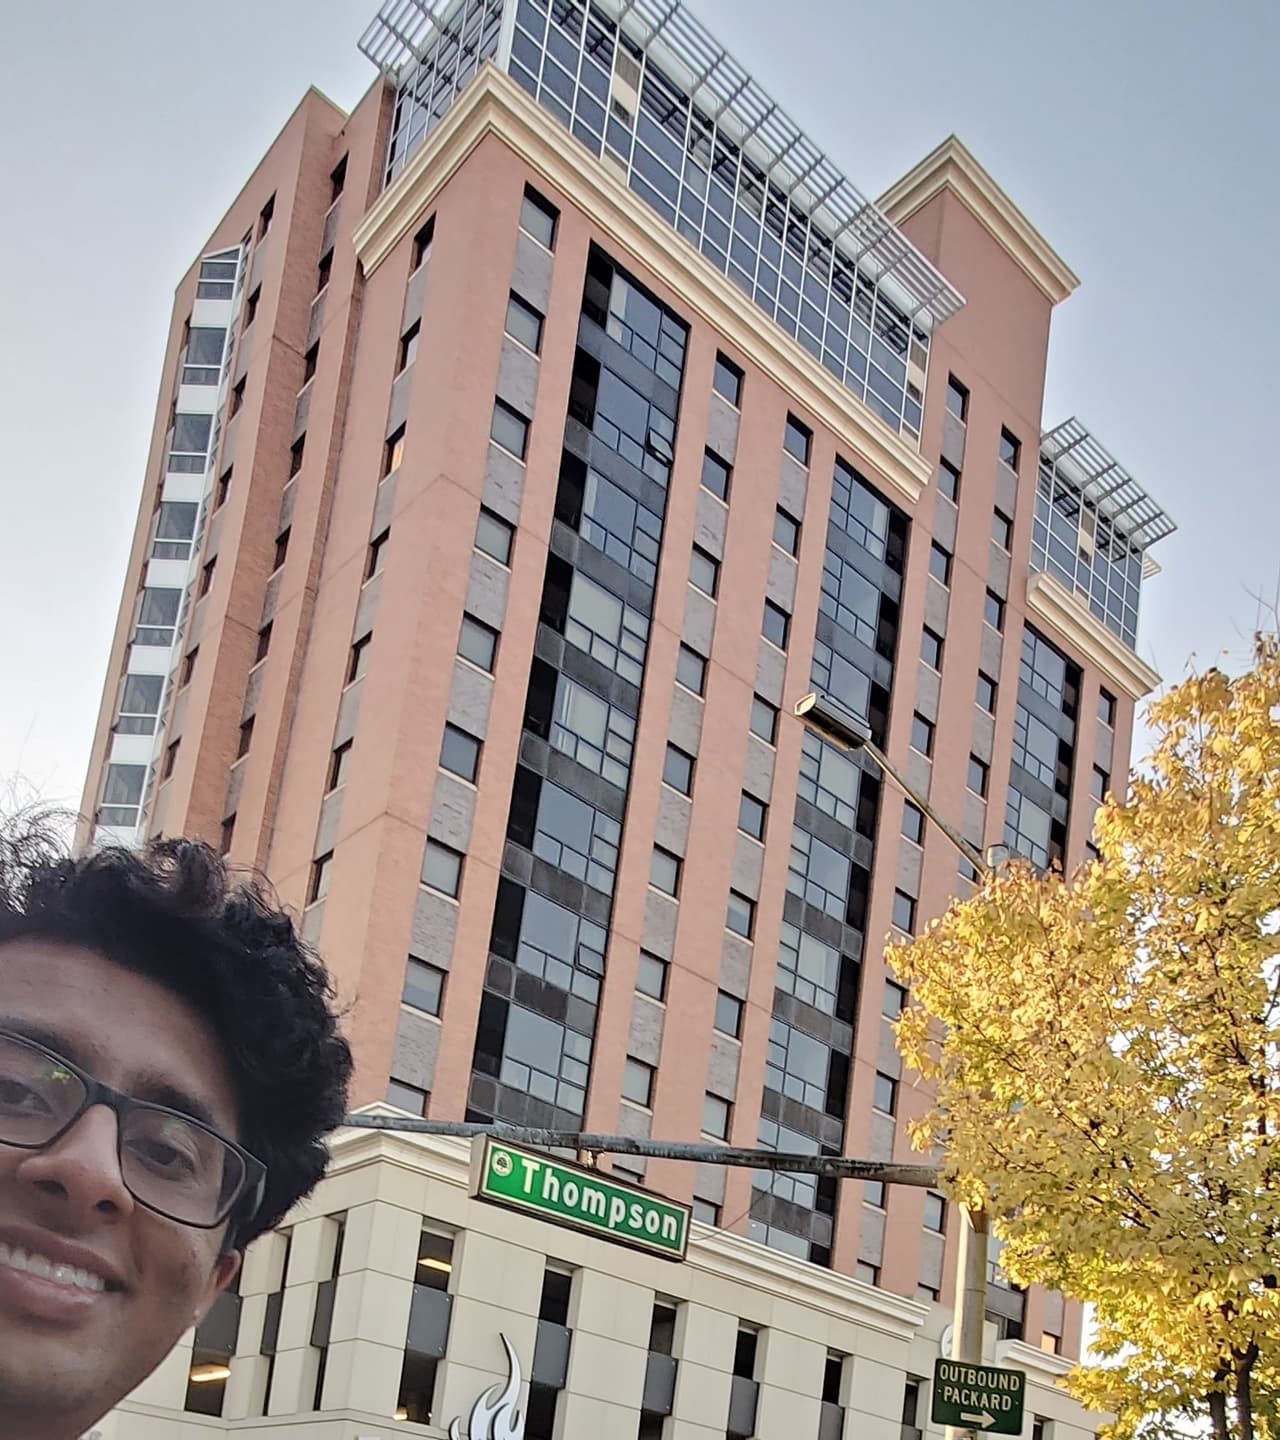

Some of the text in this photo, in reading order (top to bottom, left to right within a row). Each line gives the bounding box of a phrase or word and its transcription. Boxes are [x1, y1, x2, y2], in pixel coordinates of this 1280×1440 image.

[520, 1158, 679, 1241] Thompson
[940, 1364, 1020, 1391] OUTBOUND
[943, 1386, 1012, 1411] PACKARD
